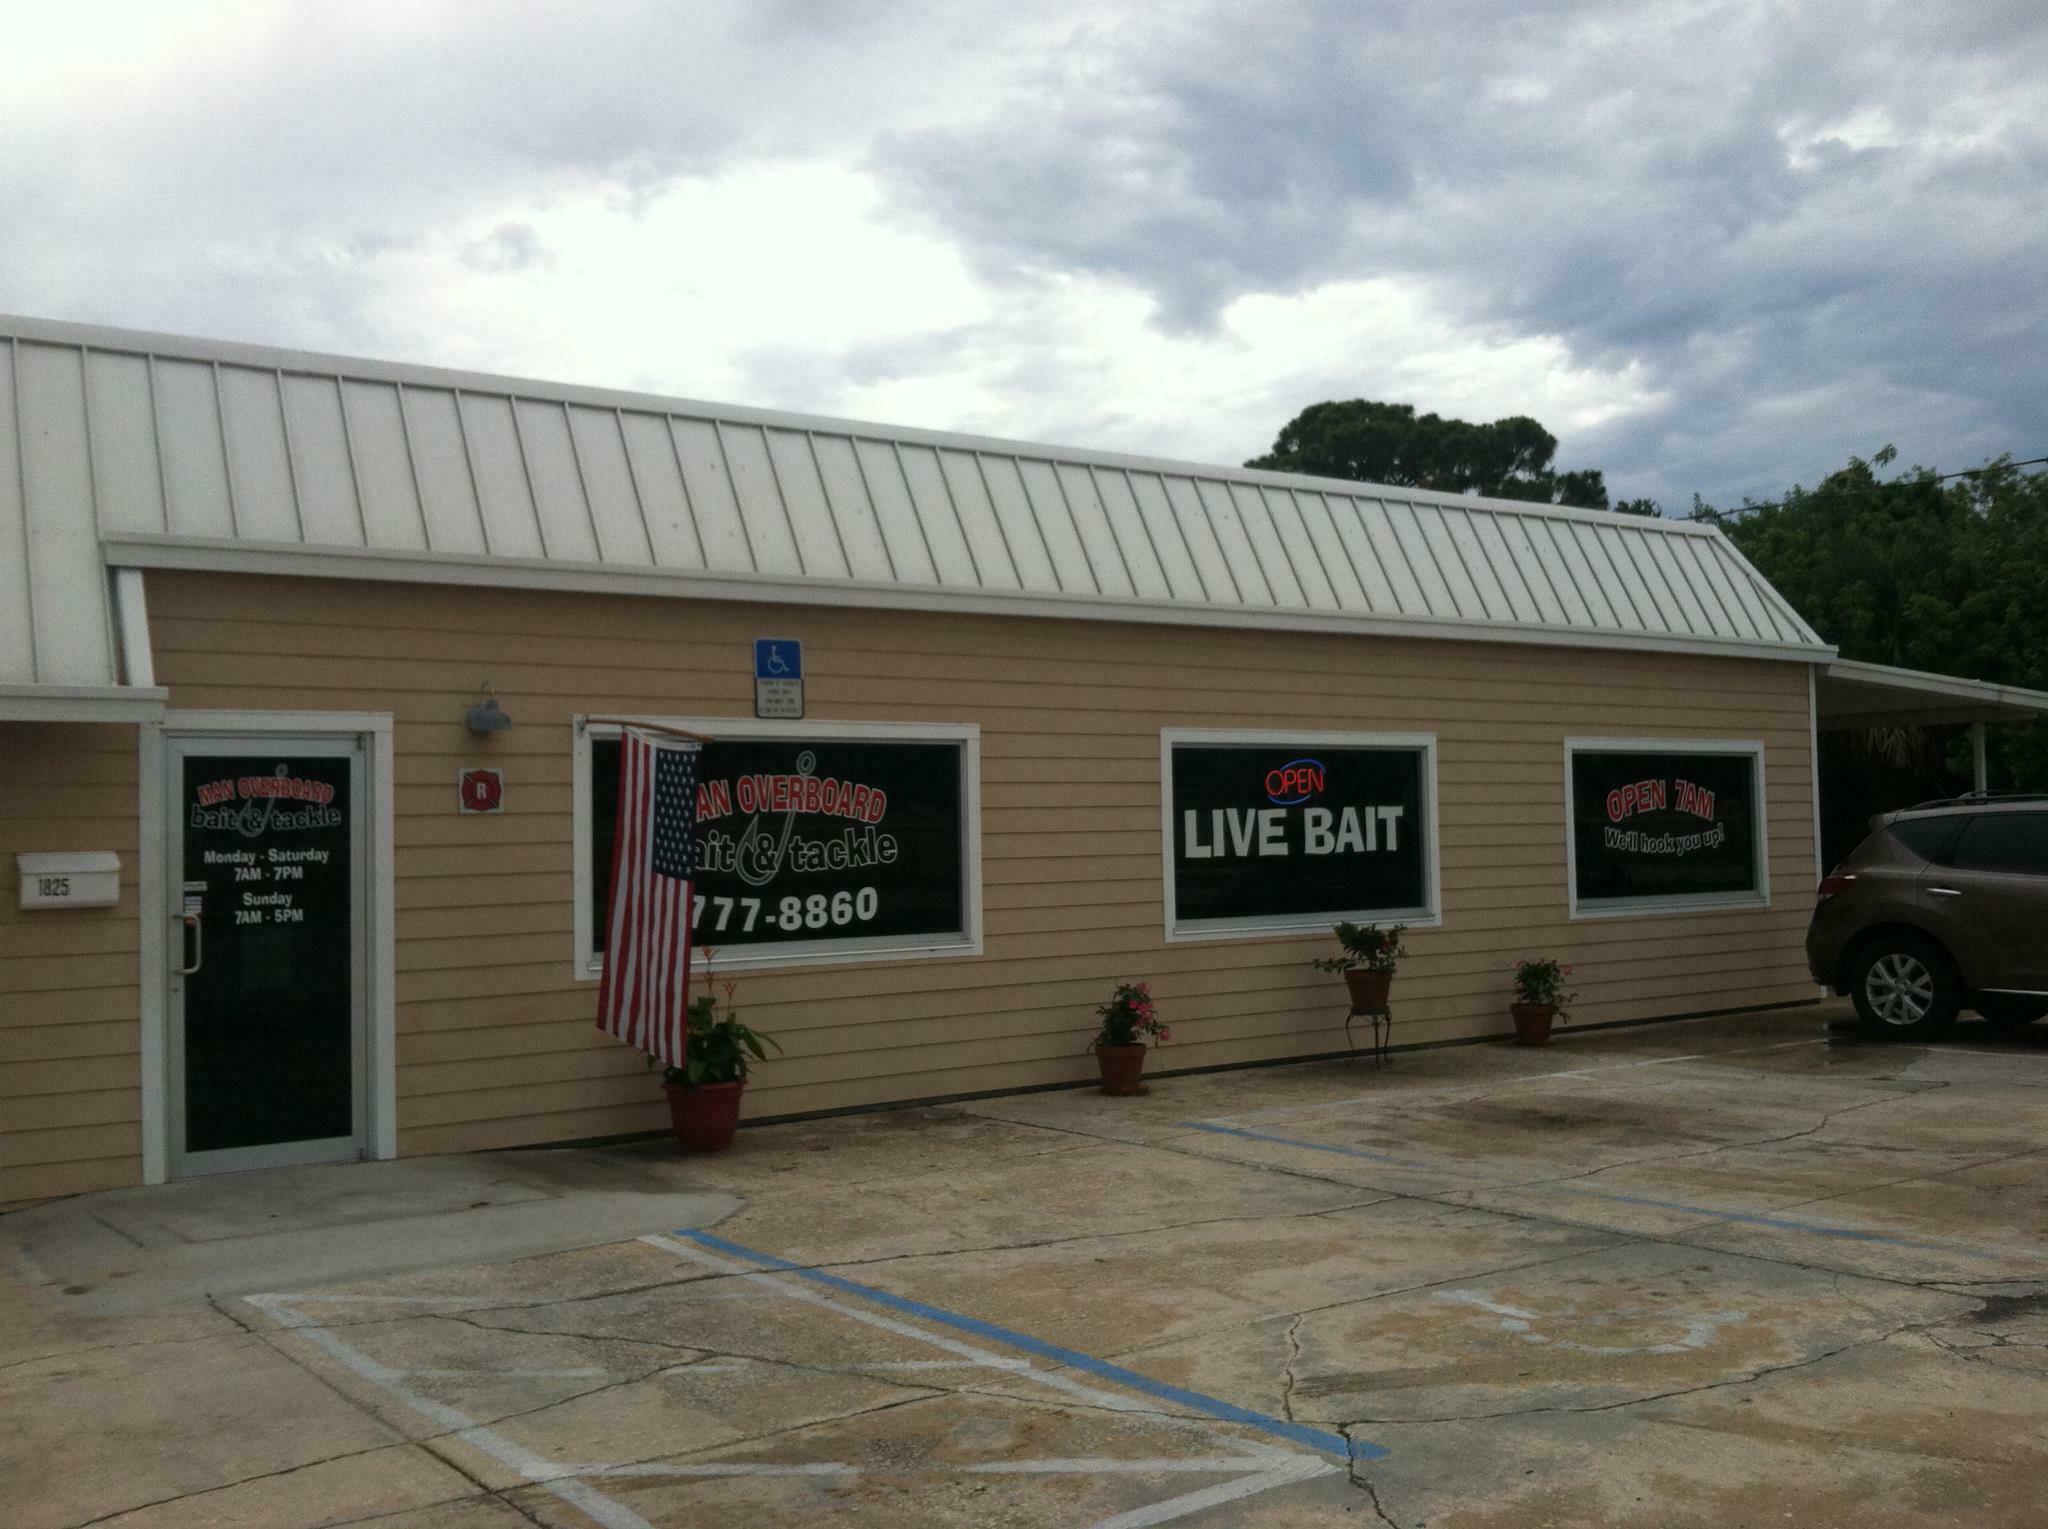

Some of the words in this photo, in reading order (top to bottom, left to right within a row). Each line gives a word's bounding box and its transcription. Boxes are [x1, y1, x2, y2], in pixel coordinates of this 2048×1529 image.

[197, 779, 235, 807] MAN
[238, 776, 334, 805] OVERBOARD
[477, 782, 487, 800] R
[1265, 768, 1325, 796] OPEN
[695, 779, 732, 822] AN
[737, 774, 887, 824] OVERBOARD
[1606, 779, 1666, 823] OPEN
[1674, 779, 1715, 822] 7AM
[191, 803, 238, 830] bait
[271, 804, 342, 831] tackle
[1184, 807, 1289, 858] LIVE
[1303, 805, 1404, 855] BAIT
[1640, 832, 1675, 854] hook
[1676, 833, 1701, 857] you
[1703, 822, 1725, 848] up!
[204, 850, 256, 866] Monday
[268, 848, 329, 864] Saturday
[693, 829, 736, 872] ait
[752, 833, 779, 872] &
[789, 826, 898, 872] tackle
[38, 878, 70, 897] 1825
[234, 867, 262, 882] 7AM
[273, 866, 303, 881] 7PM
[243, 892, 293, 907] Sunday
[235, 911, 262, 925] 7AM
[274, 909, 303, 924] 5PM
